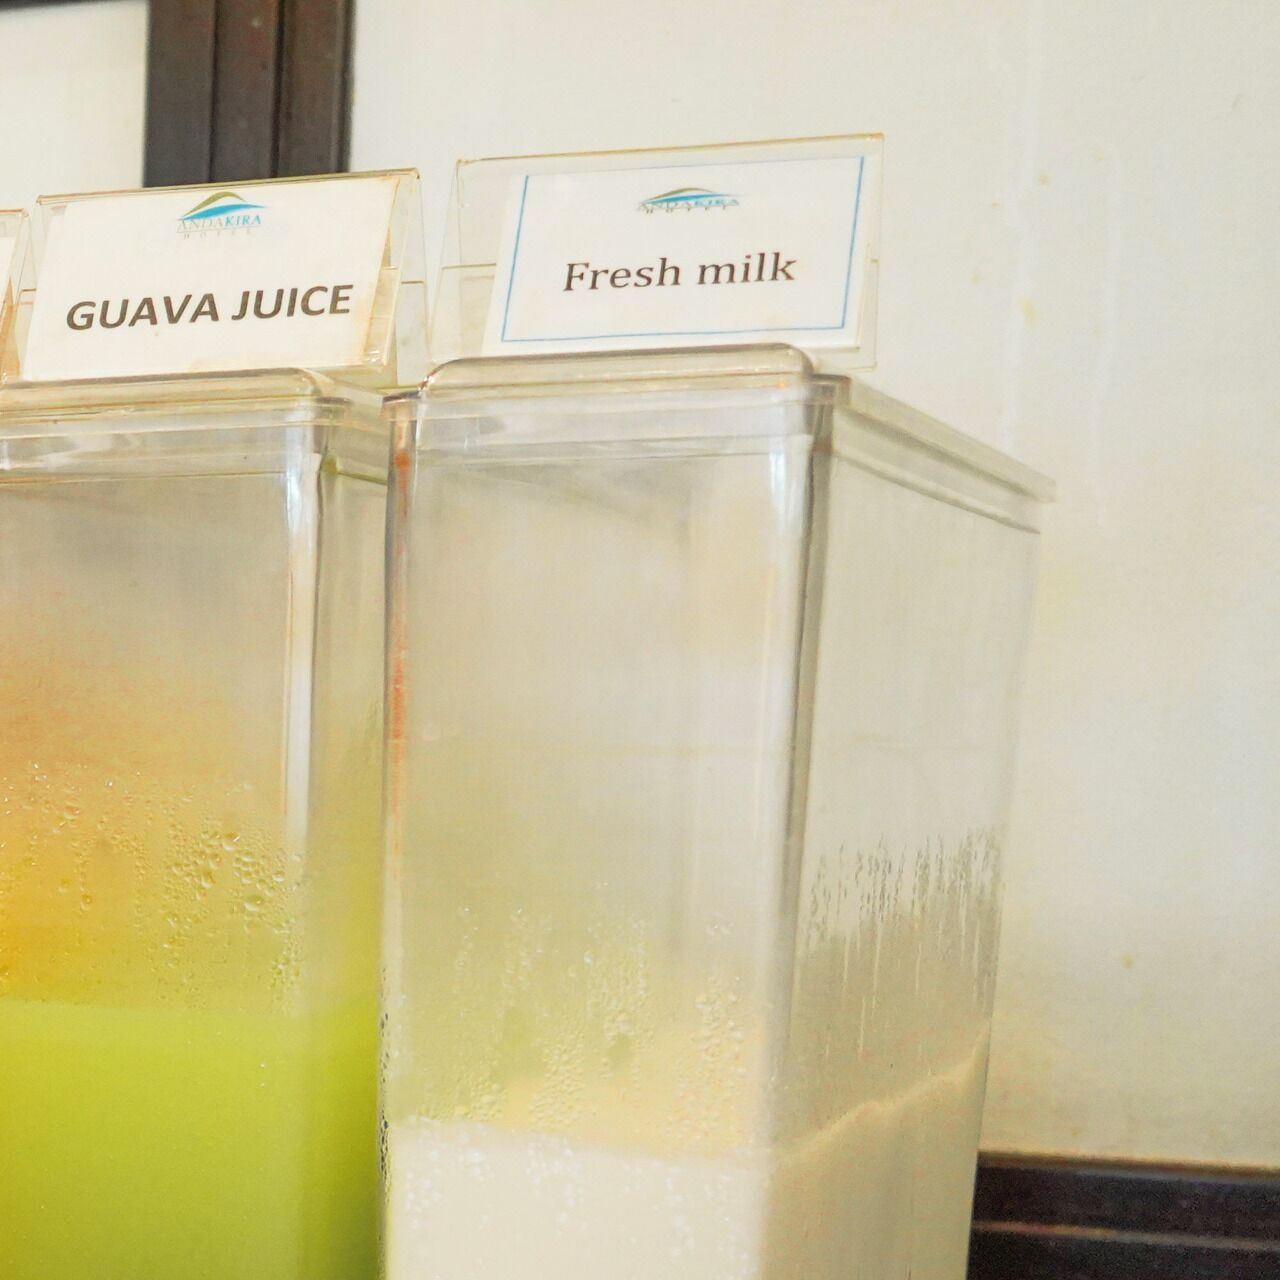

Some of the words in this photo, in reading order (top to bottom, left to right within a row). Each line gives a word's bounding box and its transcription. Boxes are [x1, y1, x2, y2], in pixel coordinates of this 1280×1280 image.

[563, 257, 681, 292] Fresh
[697, 251, 797, 286] milk
[66, 293, 220, 331] GUAVA
[231, 284, 354, 321] JUICE
